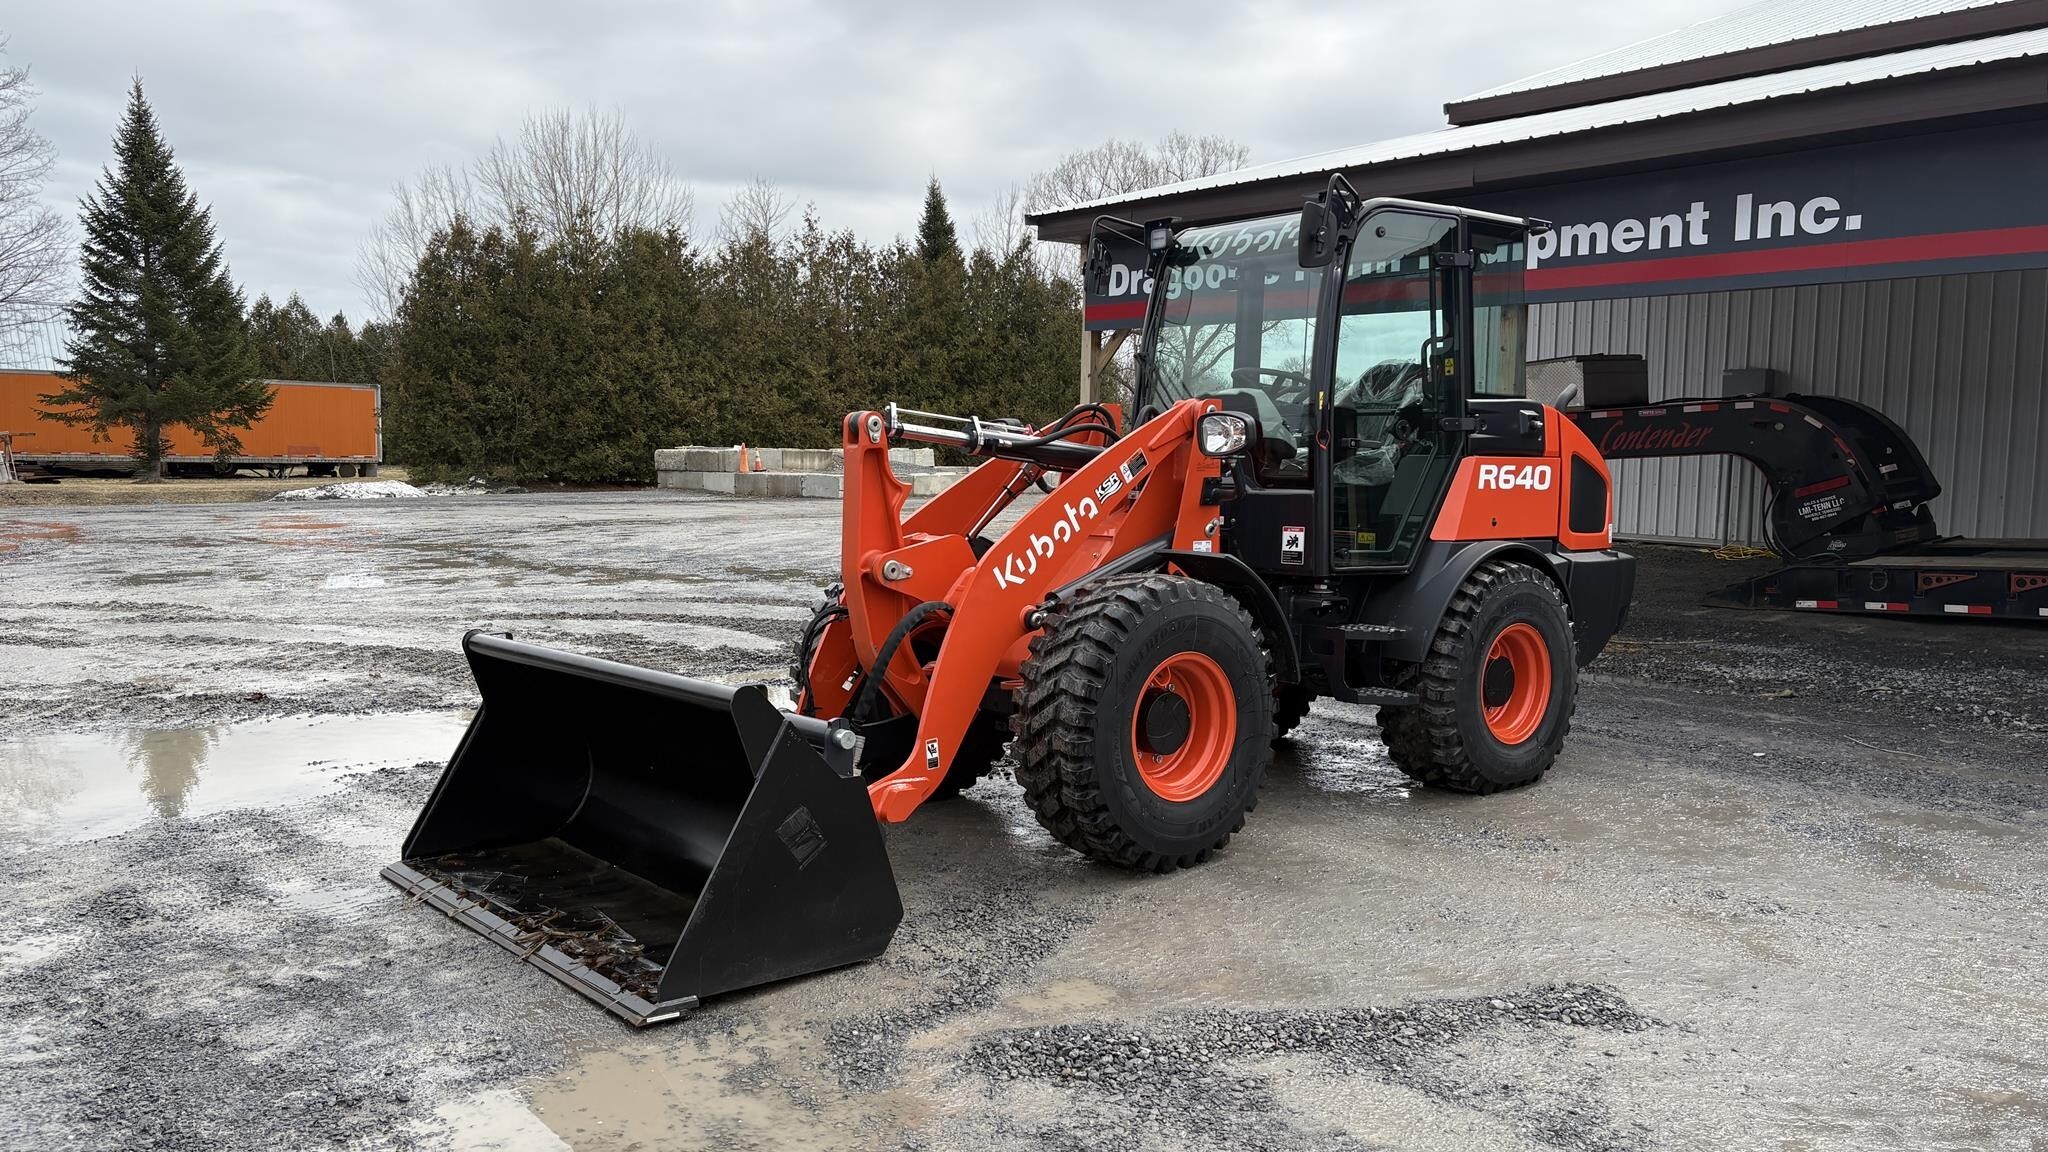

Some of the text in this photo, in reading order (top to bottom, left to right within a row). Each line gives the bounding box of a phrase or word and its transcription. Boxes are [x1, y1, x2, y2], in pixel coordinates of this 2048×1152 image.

[1734, 193, 1863, 242] Inc.
[1600, 420, 1713, 455] Contender
[1095, 472, 1121, 498] KSR
[1478, 464, 1552, 491] R640
[1798, 500, 1832, 516] LMI-TENN
[992, 496, 1100, 590] Kubota
